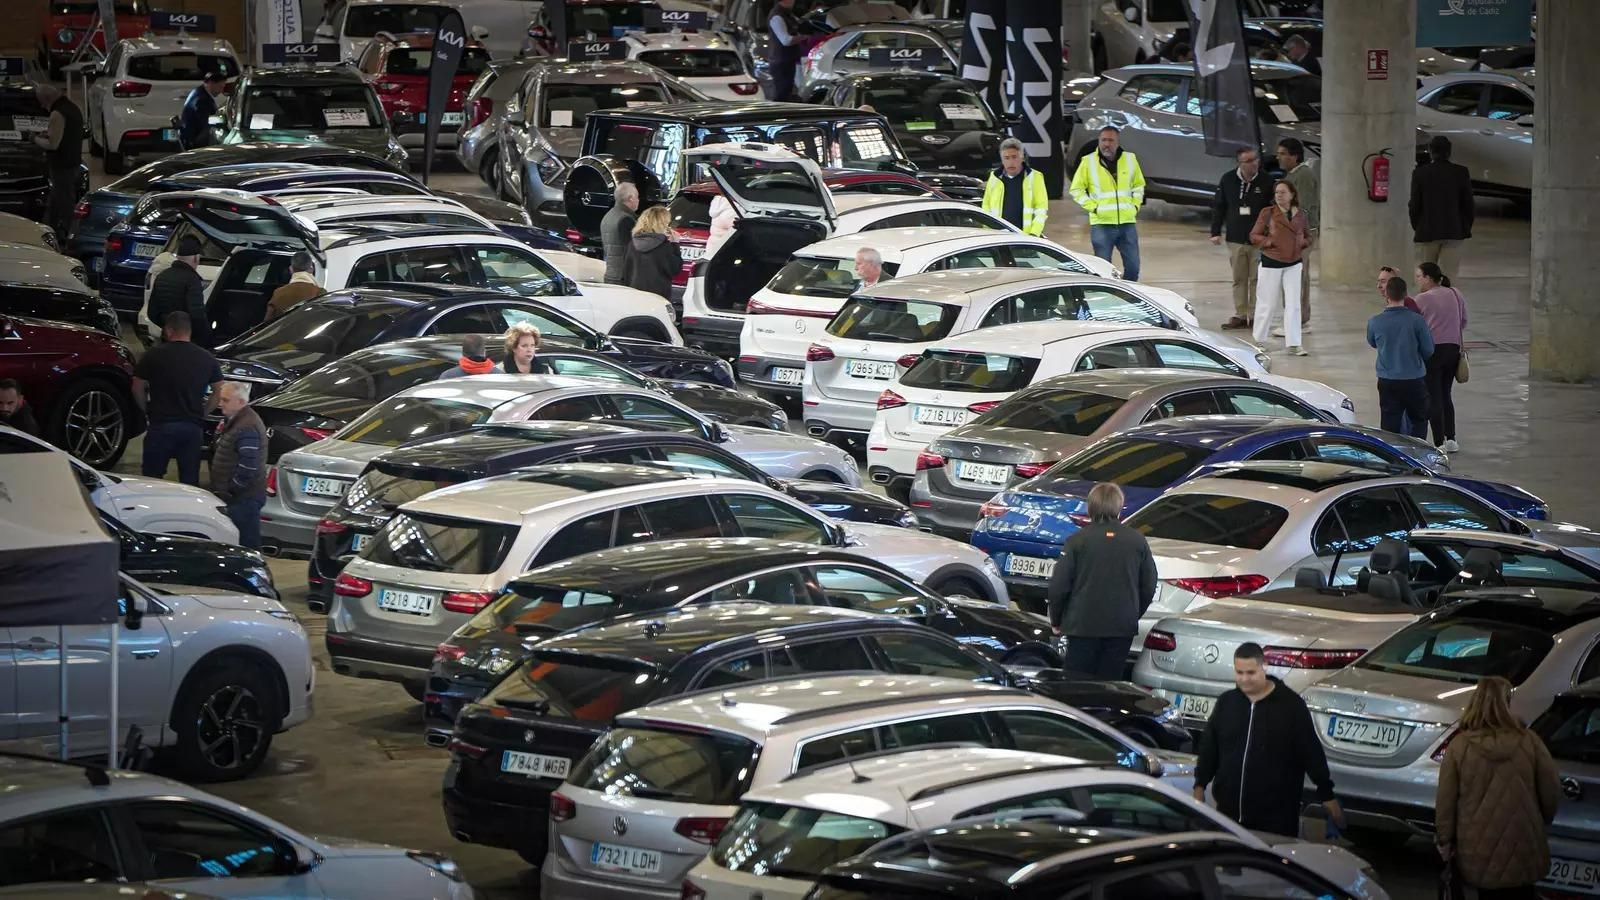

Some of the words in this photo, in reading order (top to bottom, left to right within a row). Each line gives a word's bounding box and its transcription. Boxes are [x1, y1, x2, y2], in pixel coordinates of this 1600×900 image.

[169, 14, 198, 22] KIA
[662, 12, 689, 20] KIA
[439, 28, 464, 48] KIA
[285, 45, 318, 53] KIA
[585, 43, 610, 52] KIA
[890, 49, 922, 57] KIA
[777, 369, 798, 380] 0671
[851, 362, 873, 374] 7965
[946, 411, 963, 423] LVS
[963, 464, 984, 478] 1469
[308, 479, 330, 492] 9264
[1011, 558, 1036, 573] 8936
[1038, 560, 1053, 575] MY
[384, 591, 409, 607] 8218
[1183, 697, 1209, 714] 1380
[1336, 720, 1369, 738] 5777
[1372, 725, 1396, 743] JYD
[509, 753, 540, 772] 7848
[599, 846, 628, 867] 7321
[631, 848, 657, 870] LDH
[1551, 861, 1570, 879] 20
